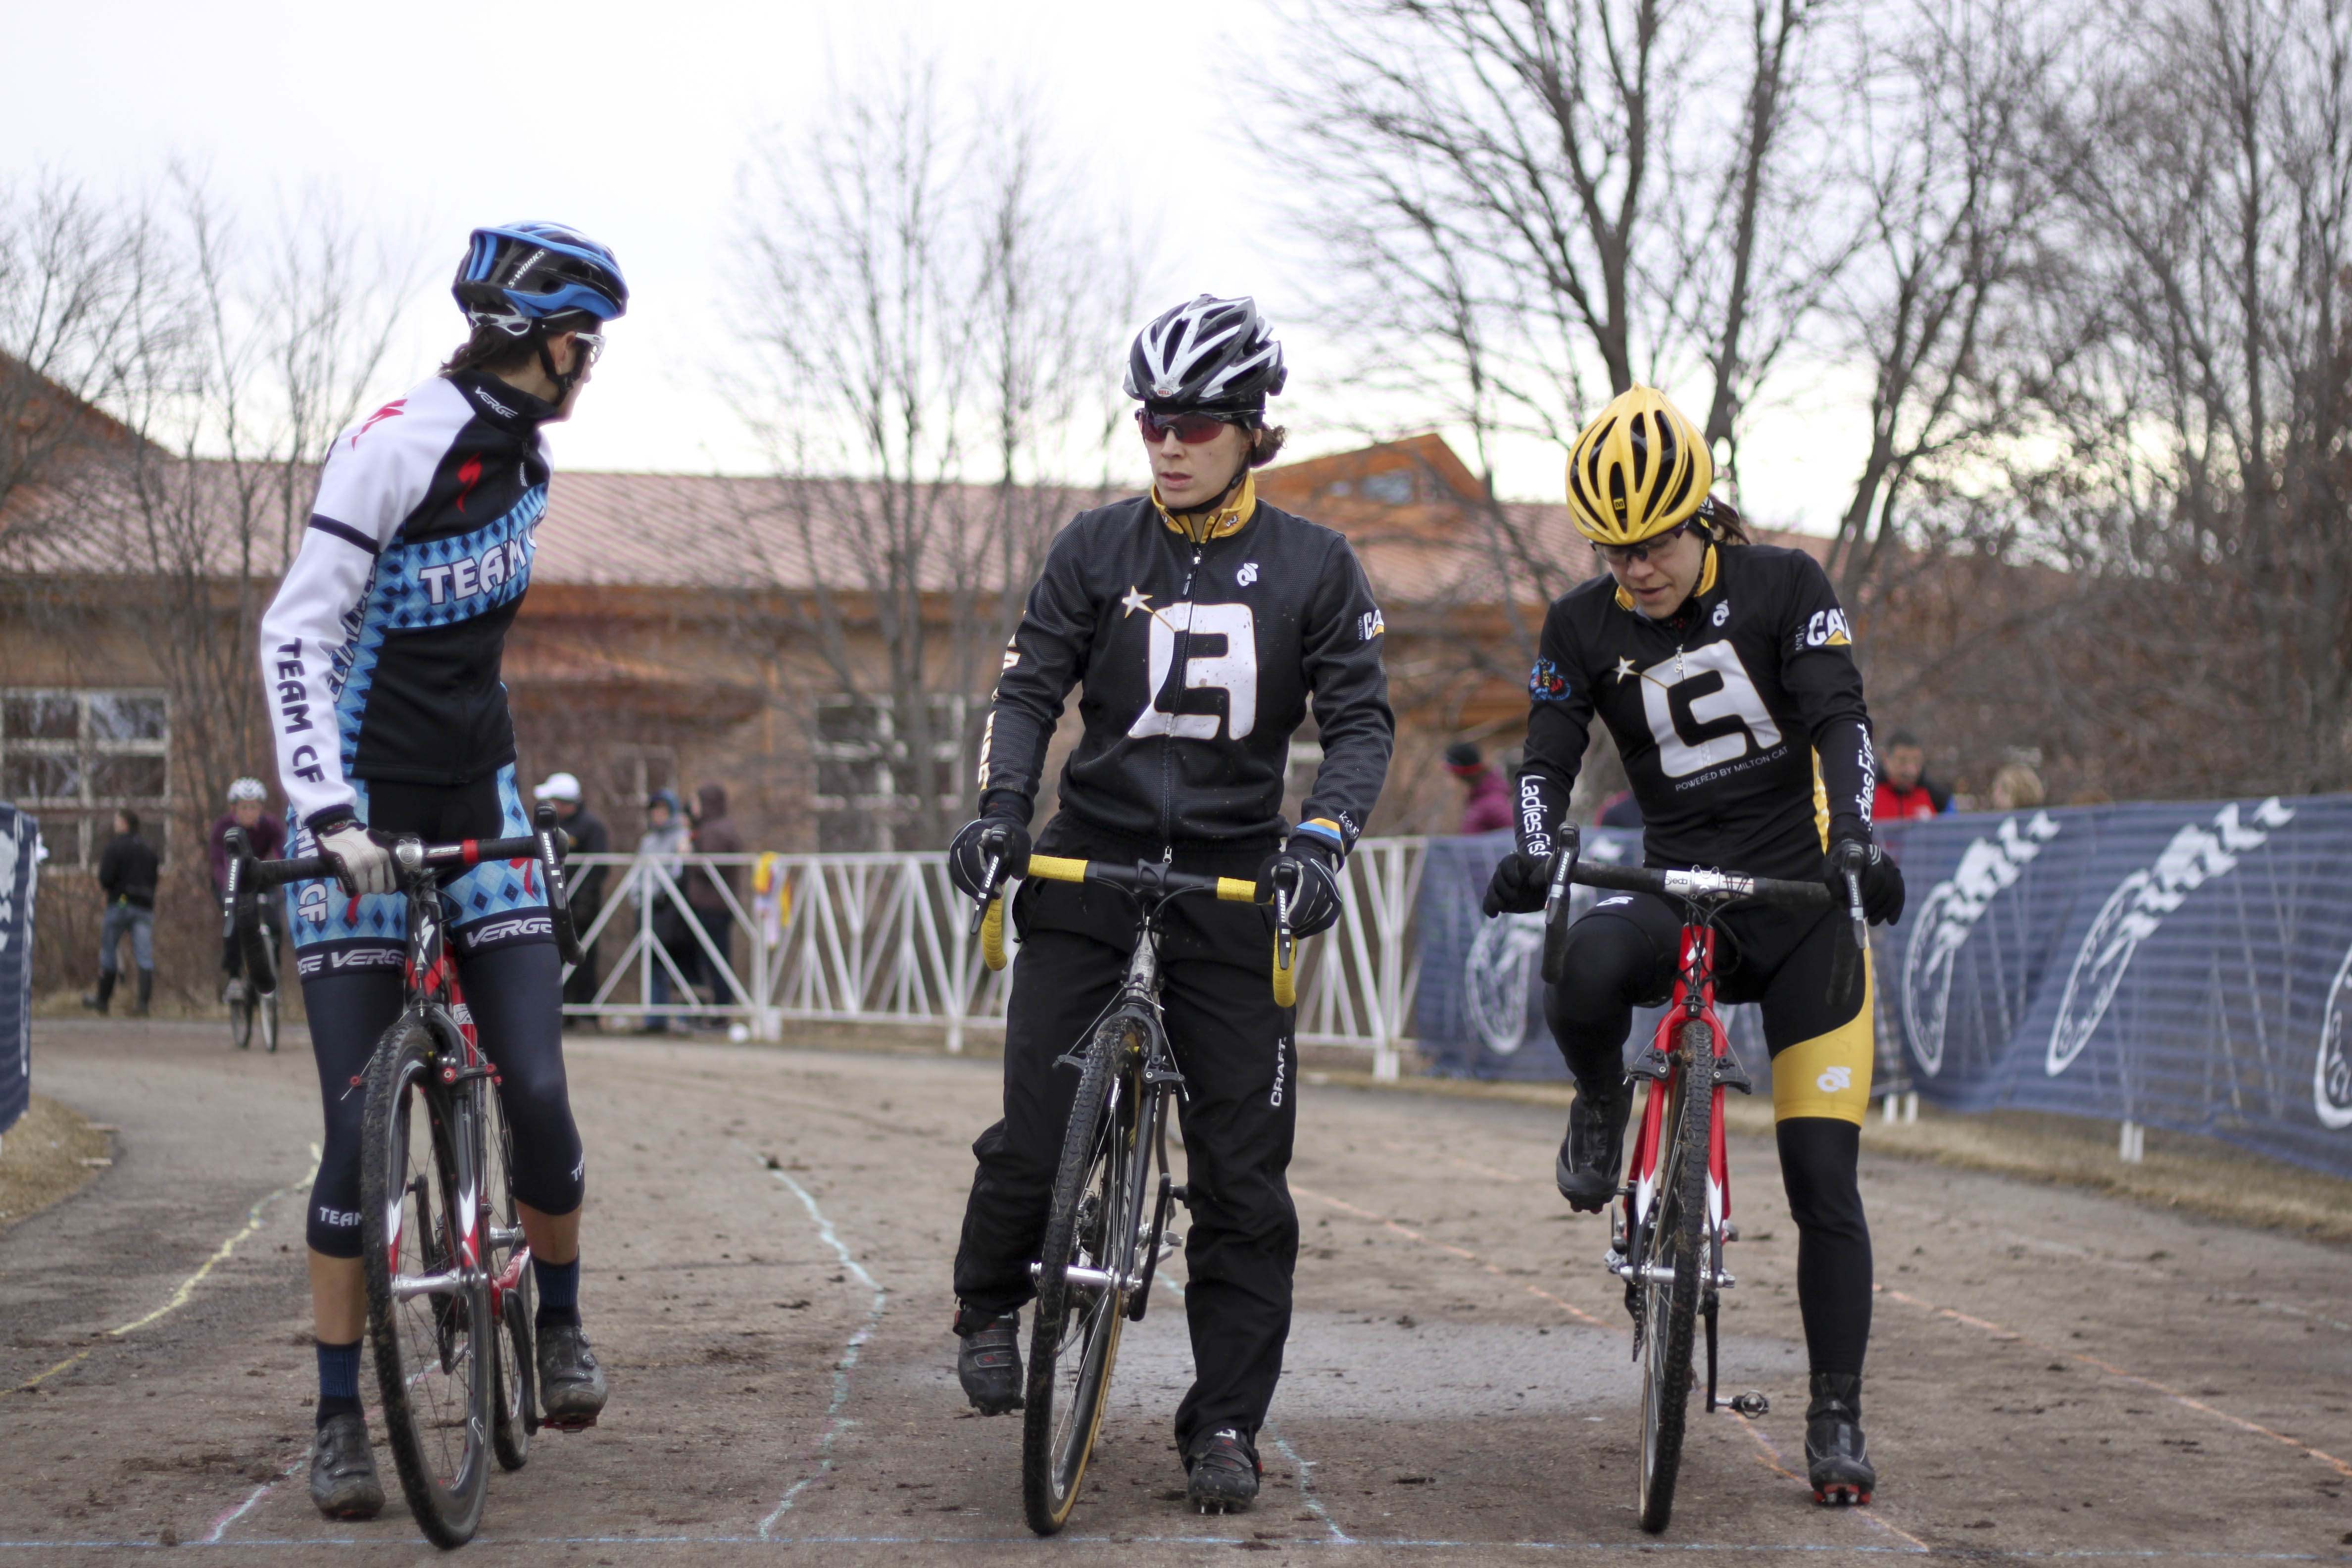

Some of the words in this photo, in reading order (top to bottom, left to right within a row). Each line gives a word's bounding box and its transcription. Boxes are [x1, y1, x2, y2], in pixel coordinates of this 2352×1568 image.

[508, 248, 544, 289] S-WORKS
[475, 386, 518, 418] VERGE
[519, 462, 528, 488] VERGE
[417, 529, 528, 606] TEAM
[276, 637, 313, 735] TEAM
[292, 744, 325, 784] CF
[1675, 771, 1717, 791] POWERED
[1719, 767, 1732, 777] BY
[1734, 755, 1770, 773] MILTON
[1771, 746, 1788, 759] CAT
[542, 832, 555, 865] SRAM
[1557, 851, 1570, 882] SRAM
[228, 858, 238, 891] SRAM
[984, 855, 999, 888] SRAM
[297, 883, 328, 923] CF
